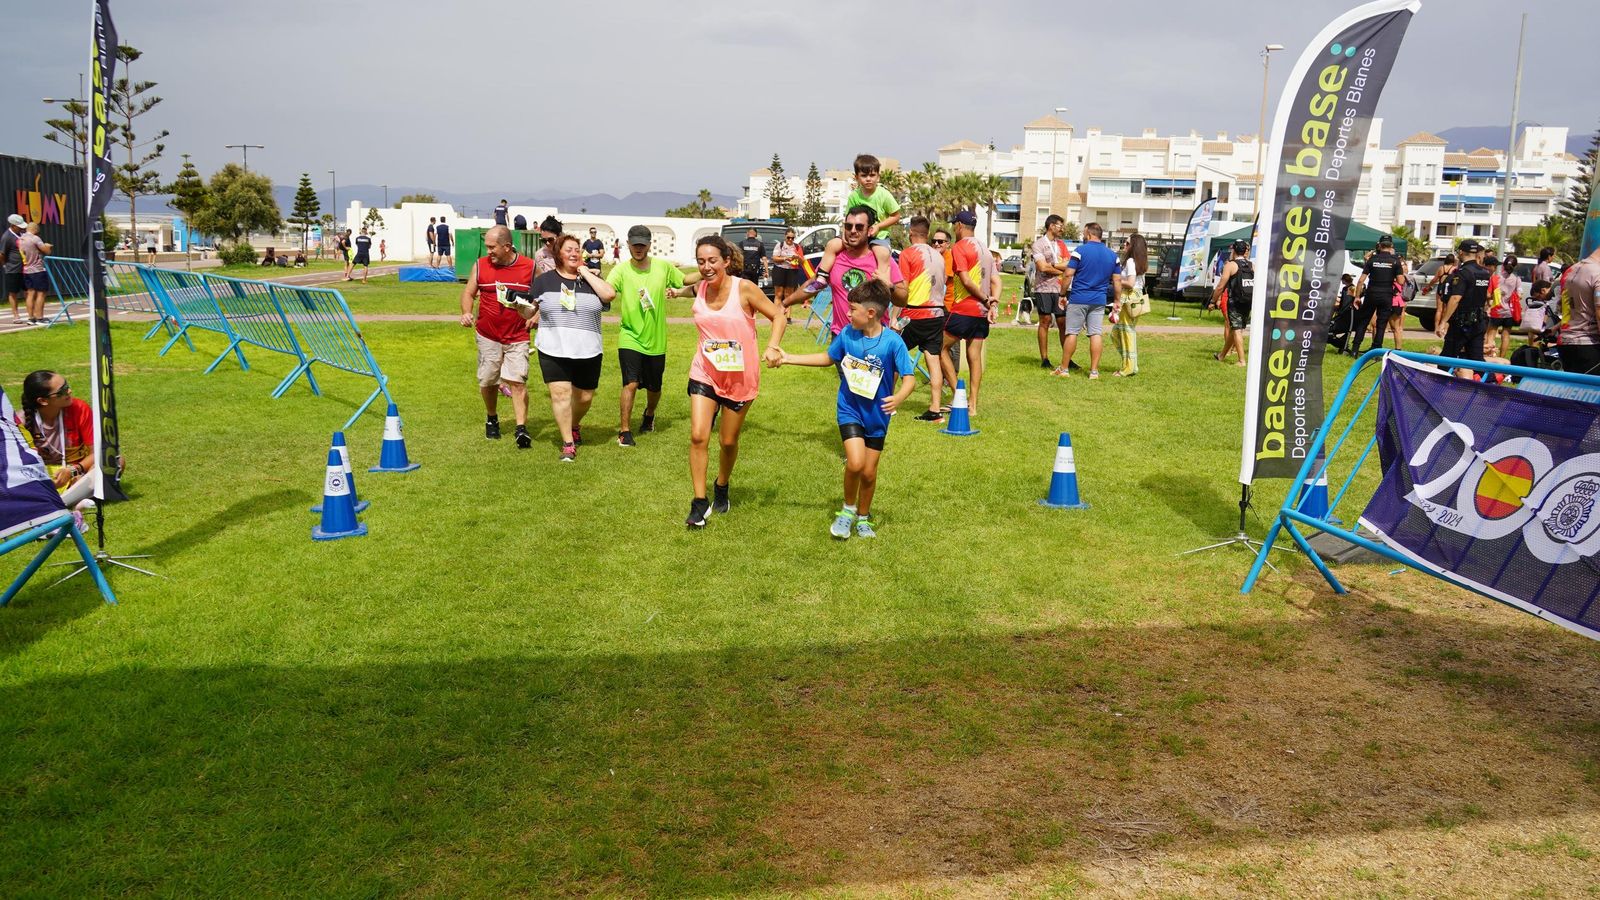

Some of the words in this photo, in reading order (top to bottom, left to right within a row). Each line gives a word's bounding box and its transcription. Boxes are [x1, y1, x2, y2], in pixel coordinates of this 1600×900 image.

[1326, 108, 1356, 181] Deportes
[1346, 48, 1376, 104] Blanes
[16, 188, 66, 226] HUMY
[1314, 190, 1336, 244] Blanes
[1302, 249, 1327, 321] Deportes
[715, 353, 737, 363] 041
[1293, 329, 1312, 383] Blanes
[1292, 387, 1310, 459] Deportes
